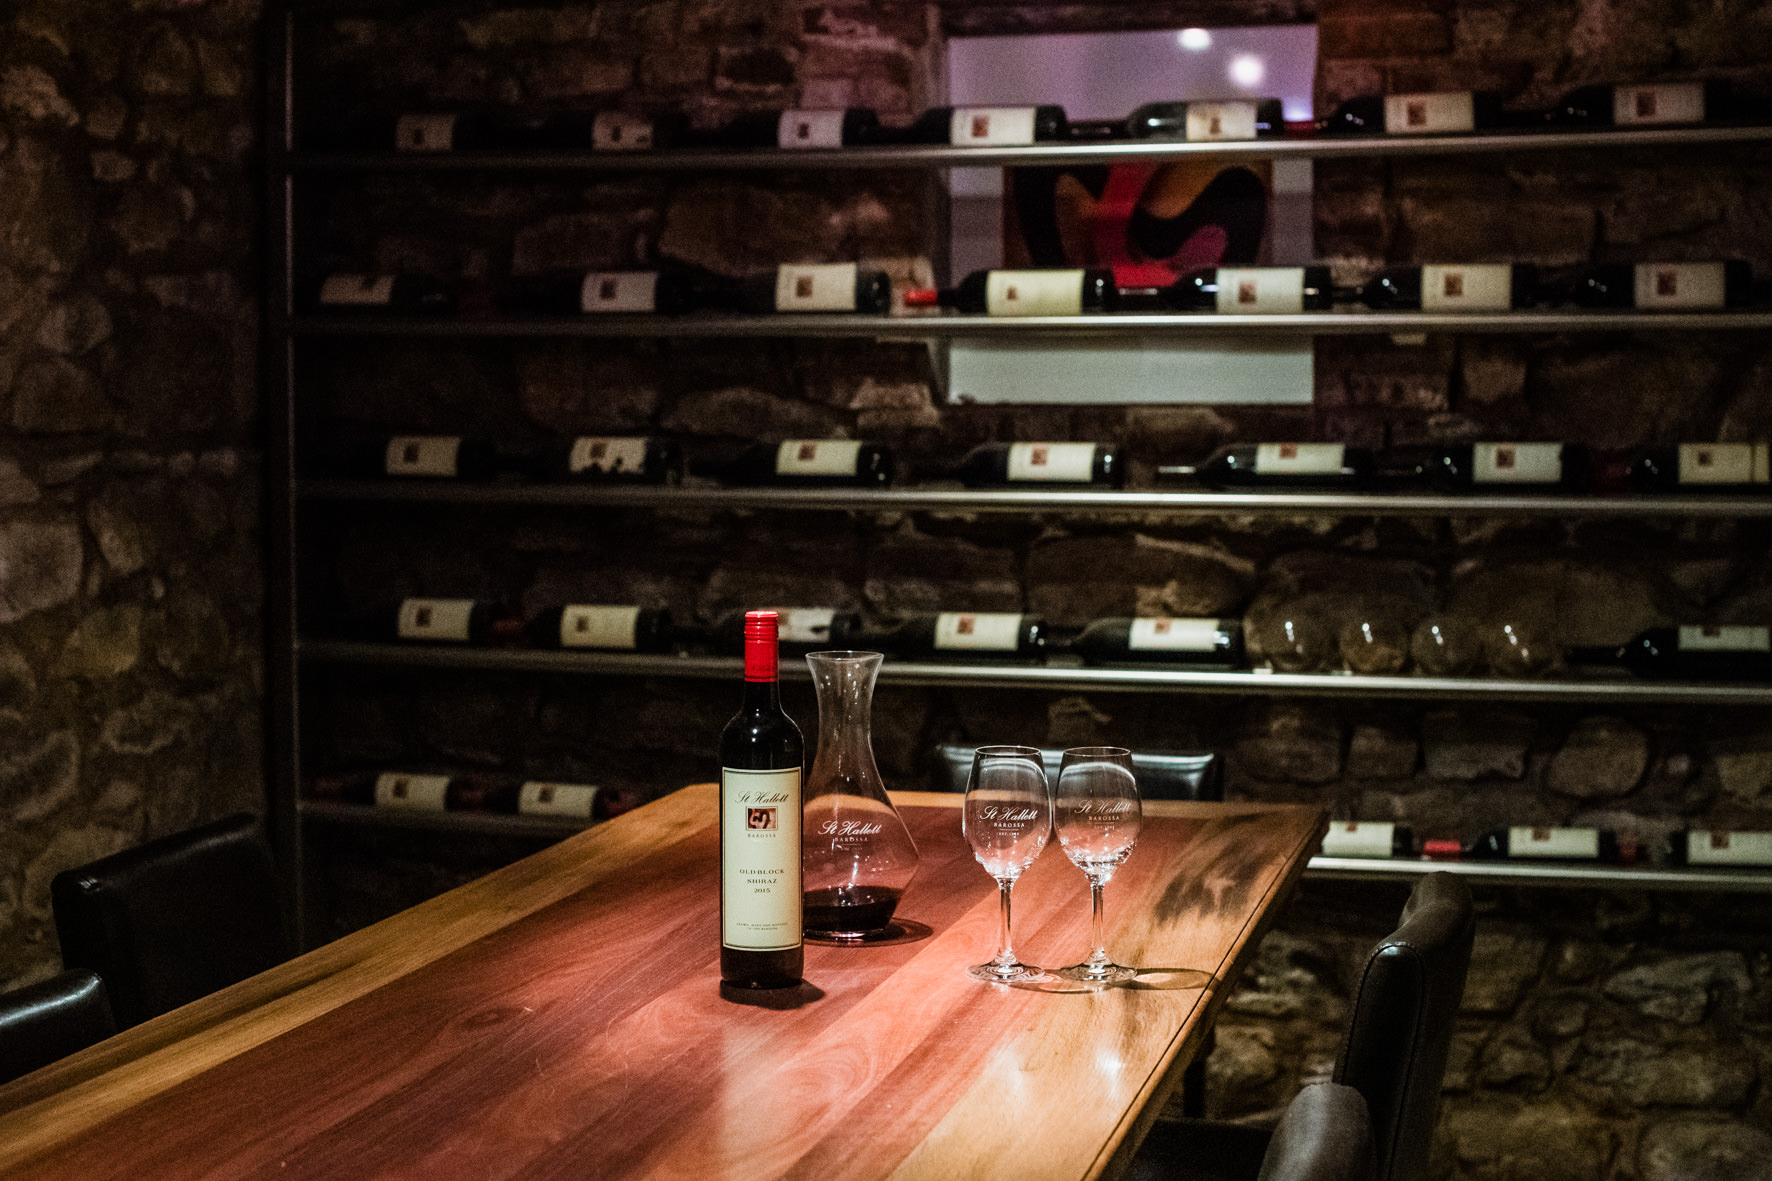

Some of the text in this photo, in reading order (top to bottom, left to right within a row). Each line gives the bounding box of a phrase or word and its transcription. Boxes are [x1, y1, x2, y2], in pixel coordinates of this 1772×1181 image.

[734, 791, 790, 803] St Hallett
[980, 805, 1037, 820] St Hallett
[1074, 799, 1131, 814] St Hallett
[817, 820, 882, 836] St Hallett
